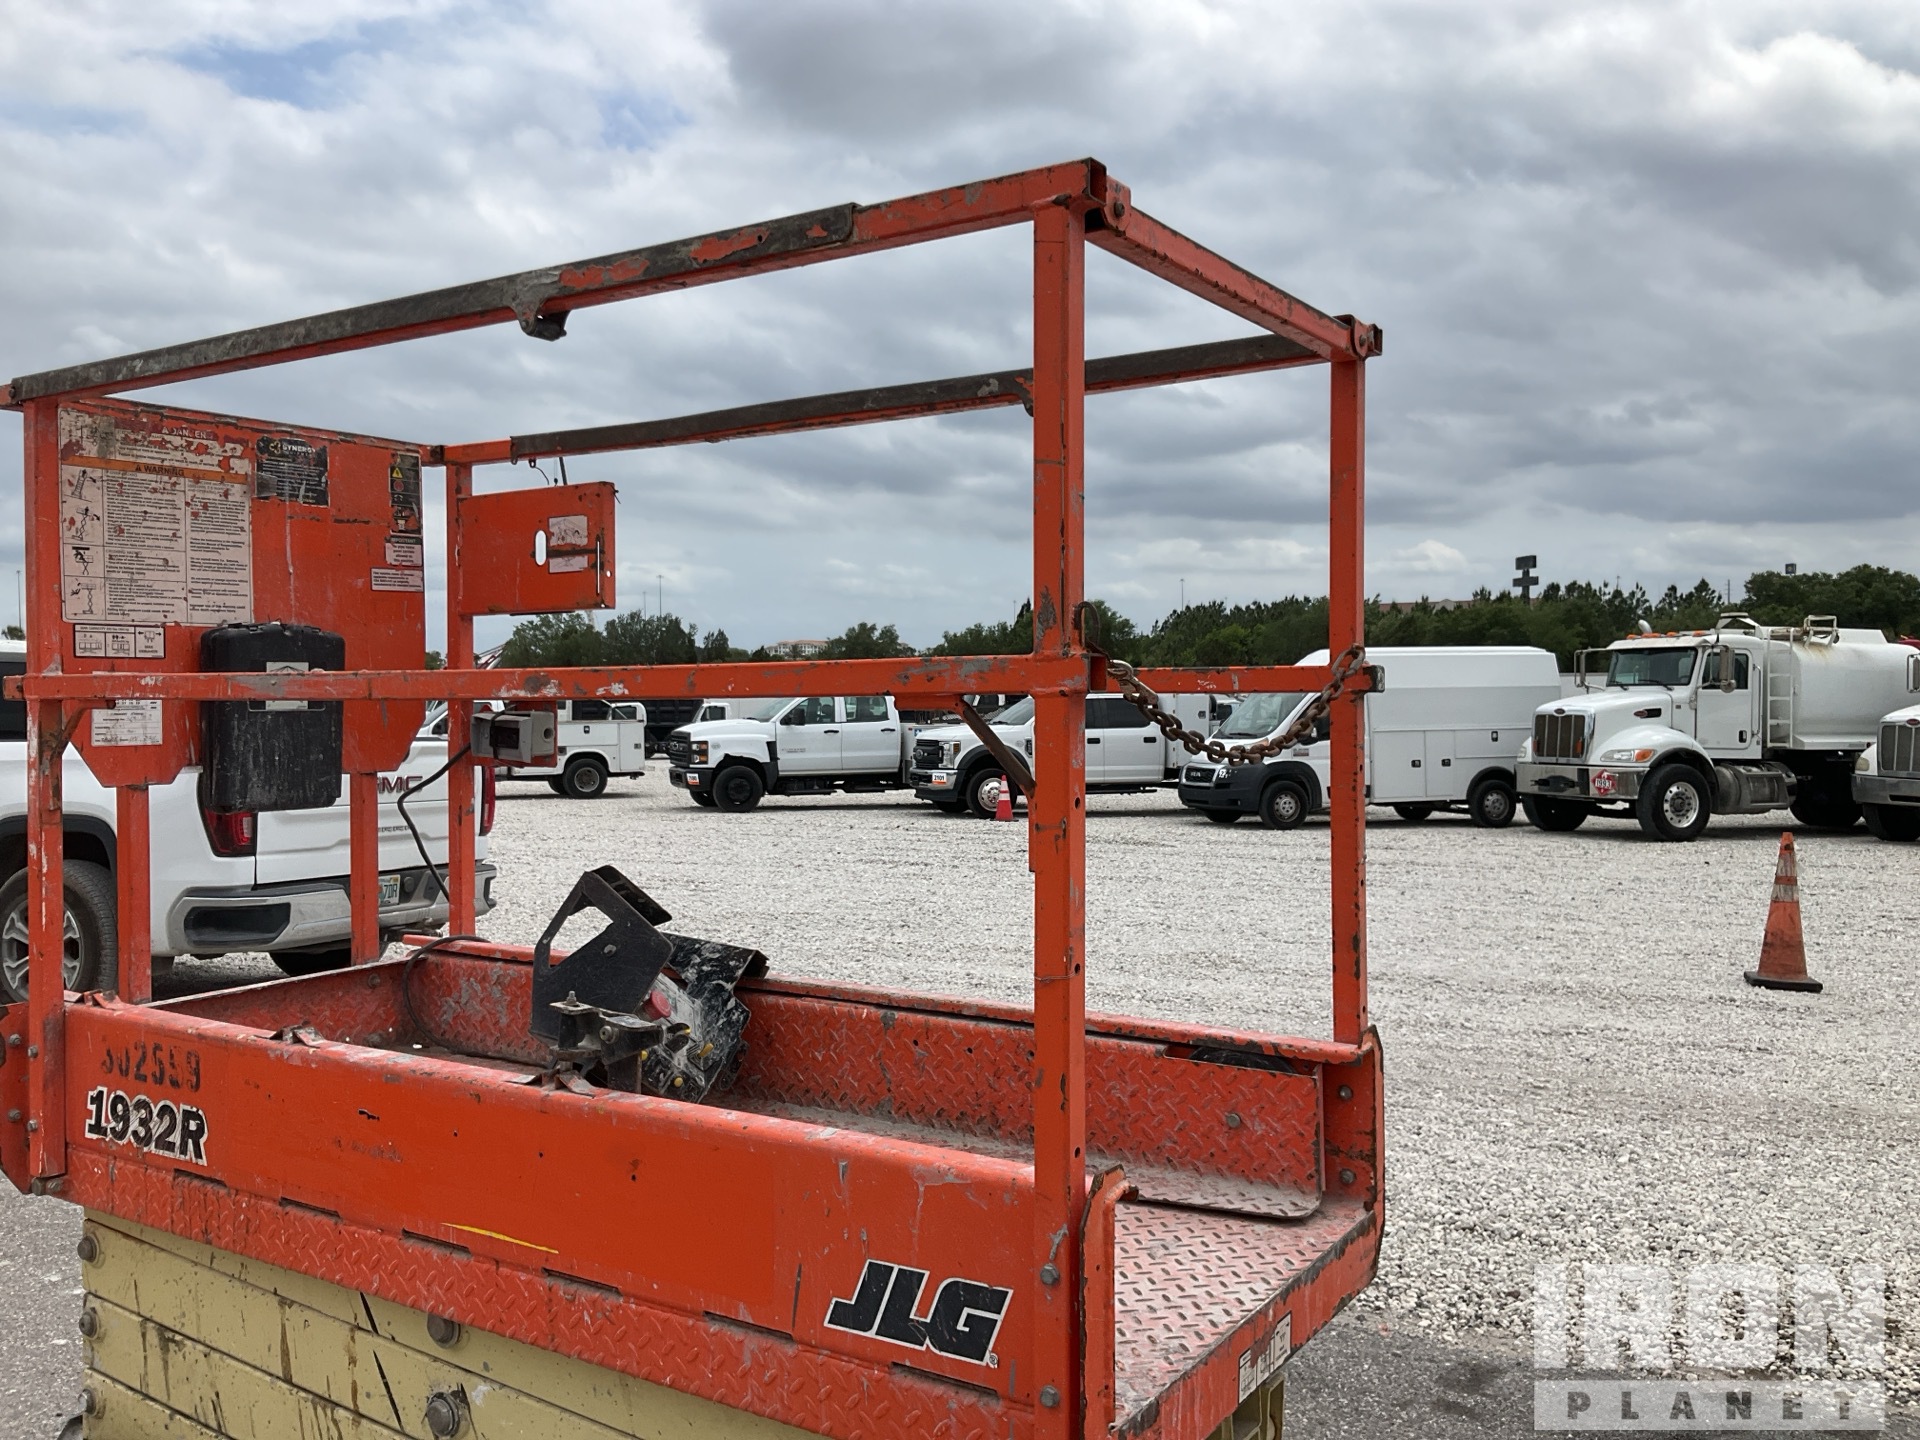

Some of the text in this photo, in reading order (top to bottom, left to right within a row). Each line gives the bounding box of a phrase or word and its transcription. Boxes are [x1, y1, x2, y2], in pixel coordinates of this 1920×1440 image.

[144, 464, 184, 476] WARNING
[378, 776, 423, 793] MC
[85, 1086, 208, 1166] 1932R
[824, 1258, 1014, 1366] JLG
